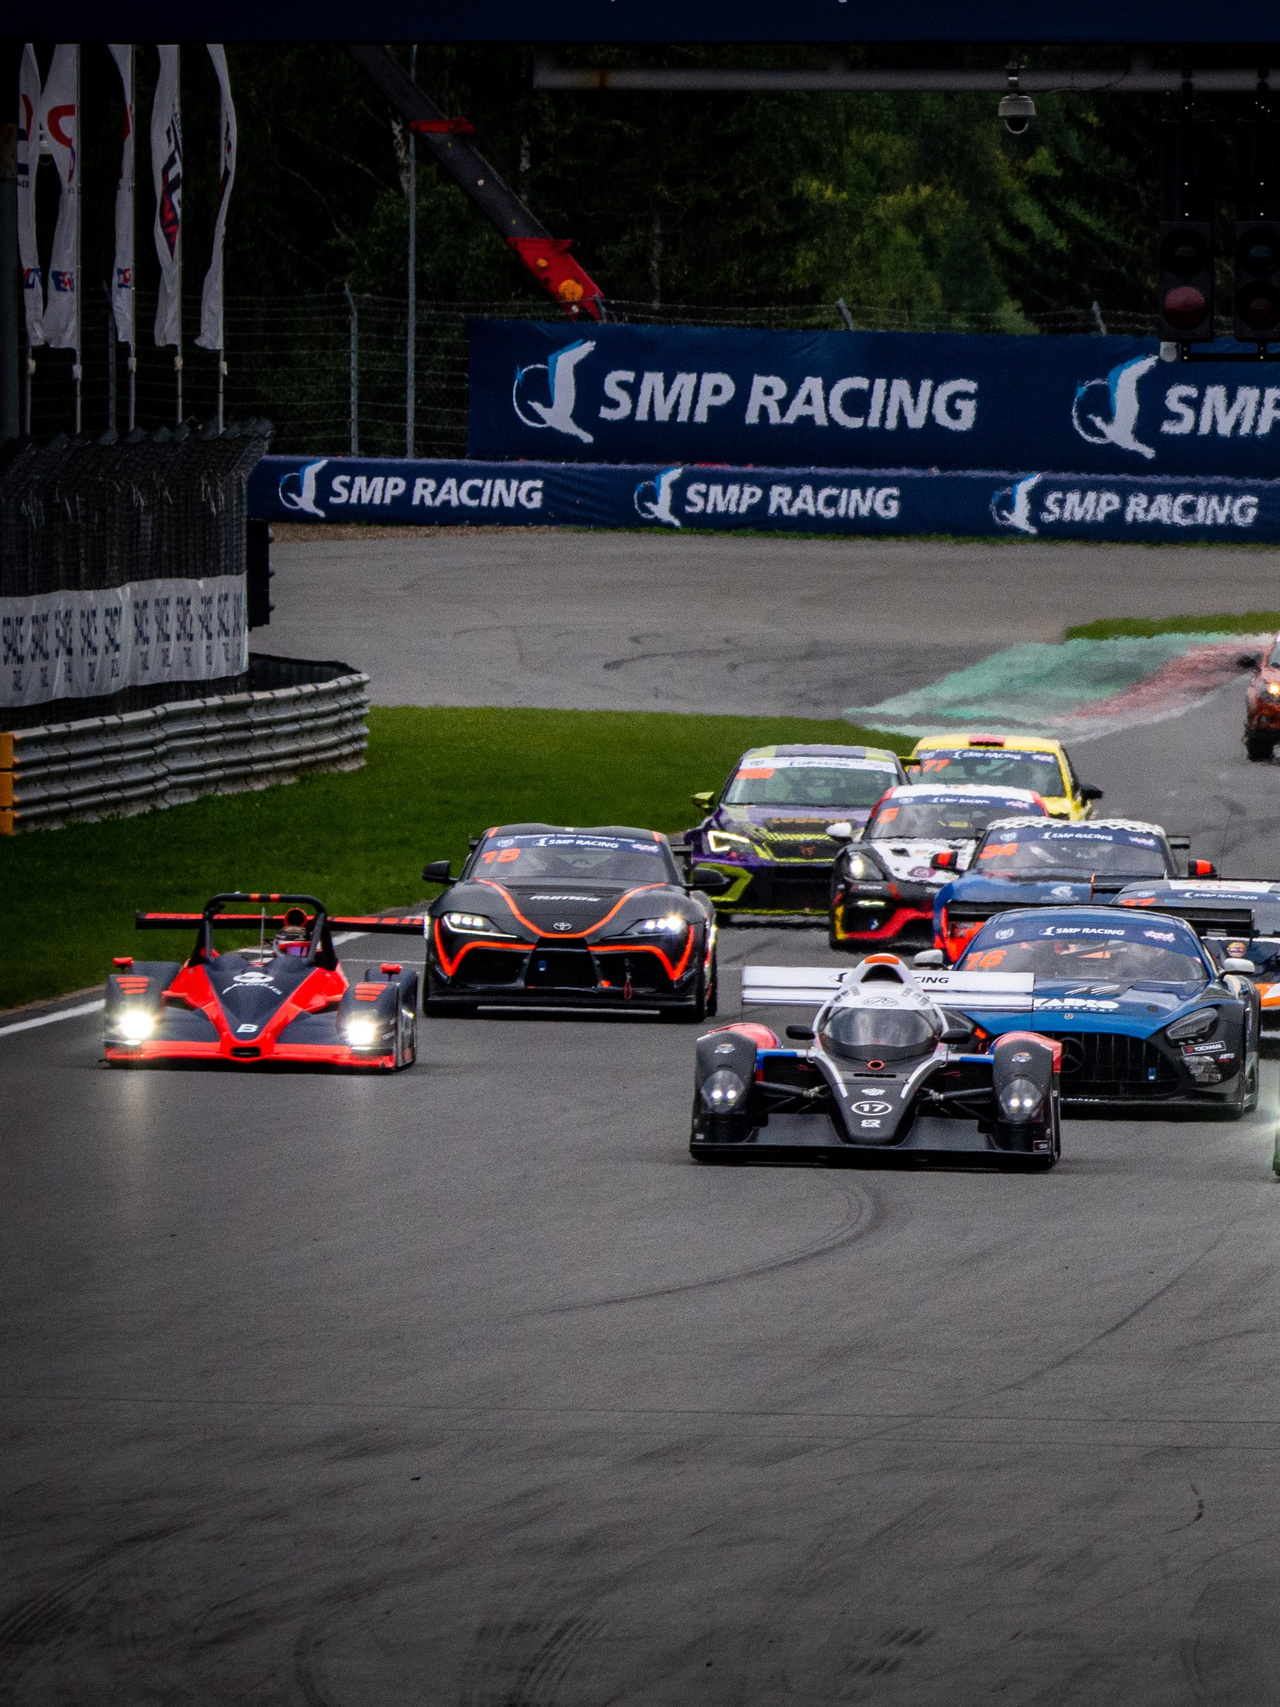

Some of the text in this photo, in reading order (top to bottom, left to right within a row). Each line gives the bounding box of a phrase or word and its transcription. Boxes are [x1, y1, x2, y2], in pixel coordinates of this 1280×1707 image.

[599, 370, 978, 431] SMP RACING
[329, 474, 544, 509] SMP RACING
[684, 482, 901, 519] SMP RACING
[1041, 490, 1259, 527] SMP RACING
[548, 838, 575, 846] SMP
[575, 838, 620, 849] RACING
[481, 847, 521, 865] 18
[1055, 926, 1126, 936] SMP RACING
[965, 948, 1008, 971] 16
[1034, 1005, 1114, 1013] OTORSPORT
[236, 1023, 259, 1034] B
[858, 1102, 885, 1114] 17
